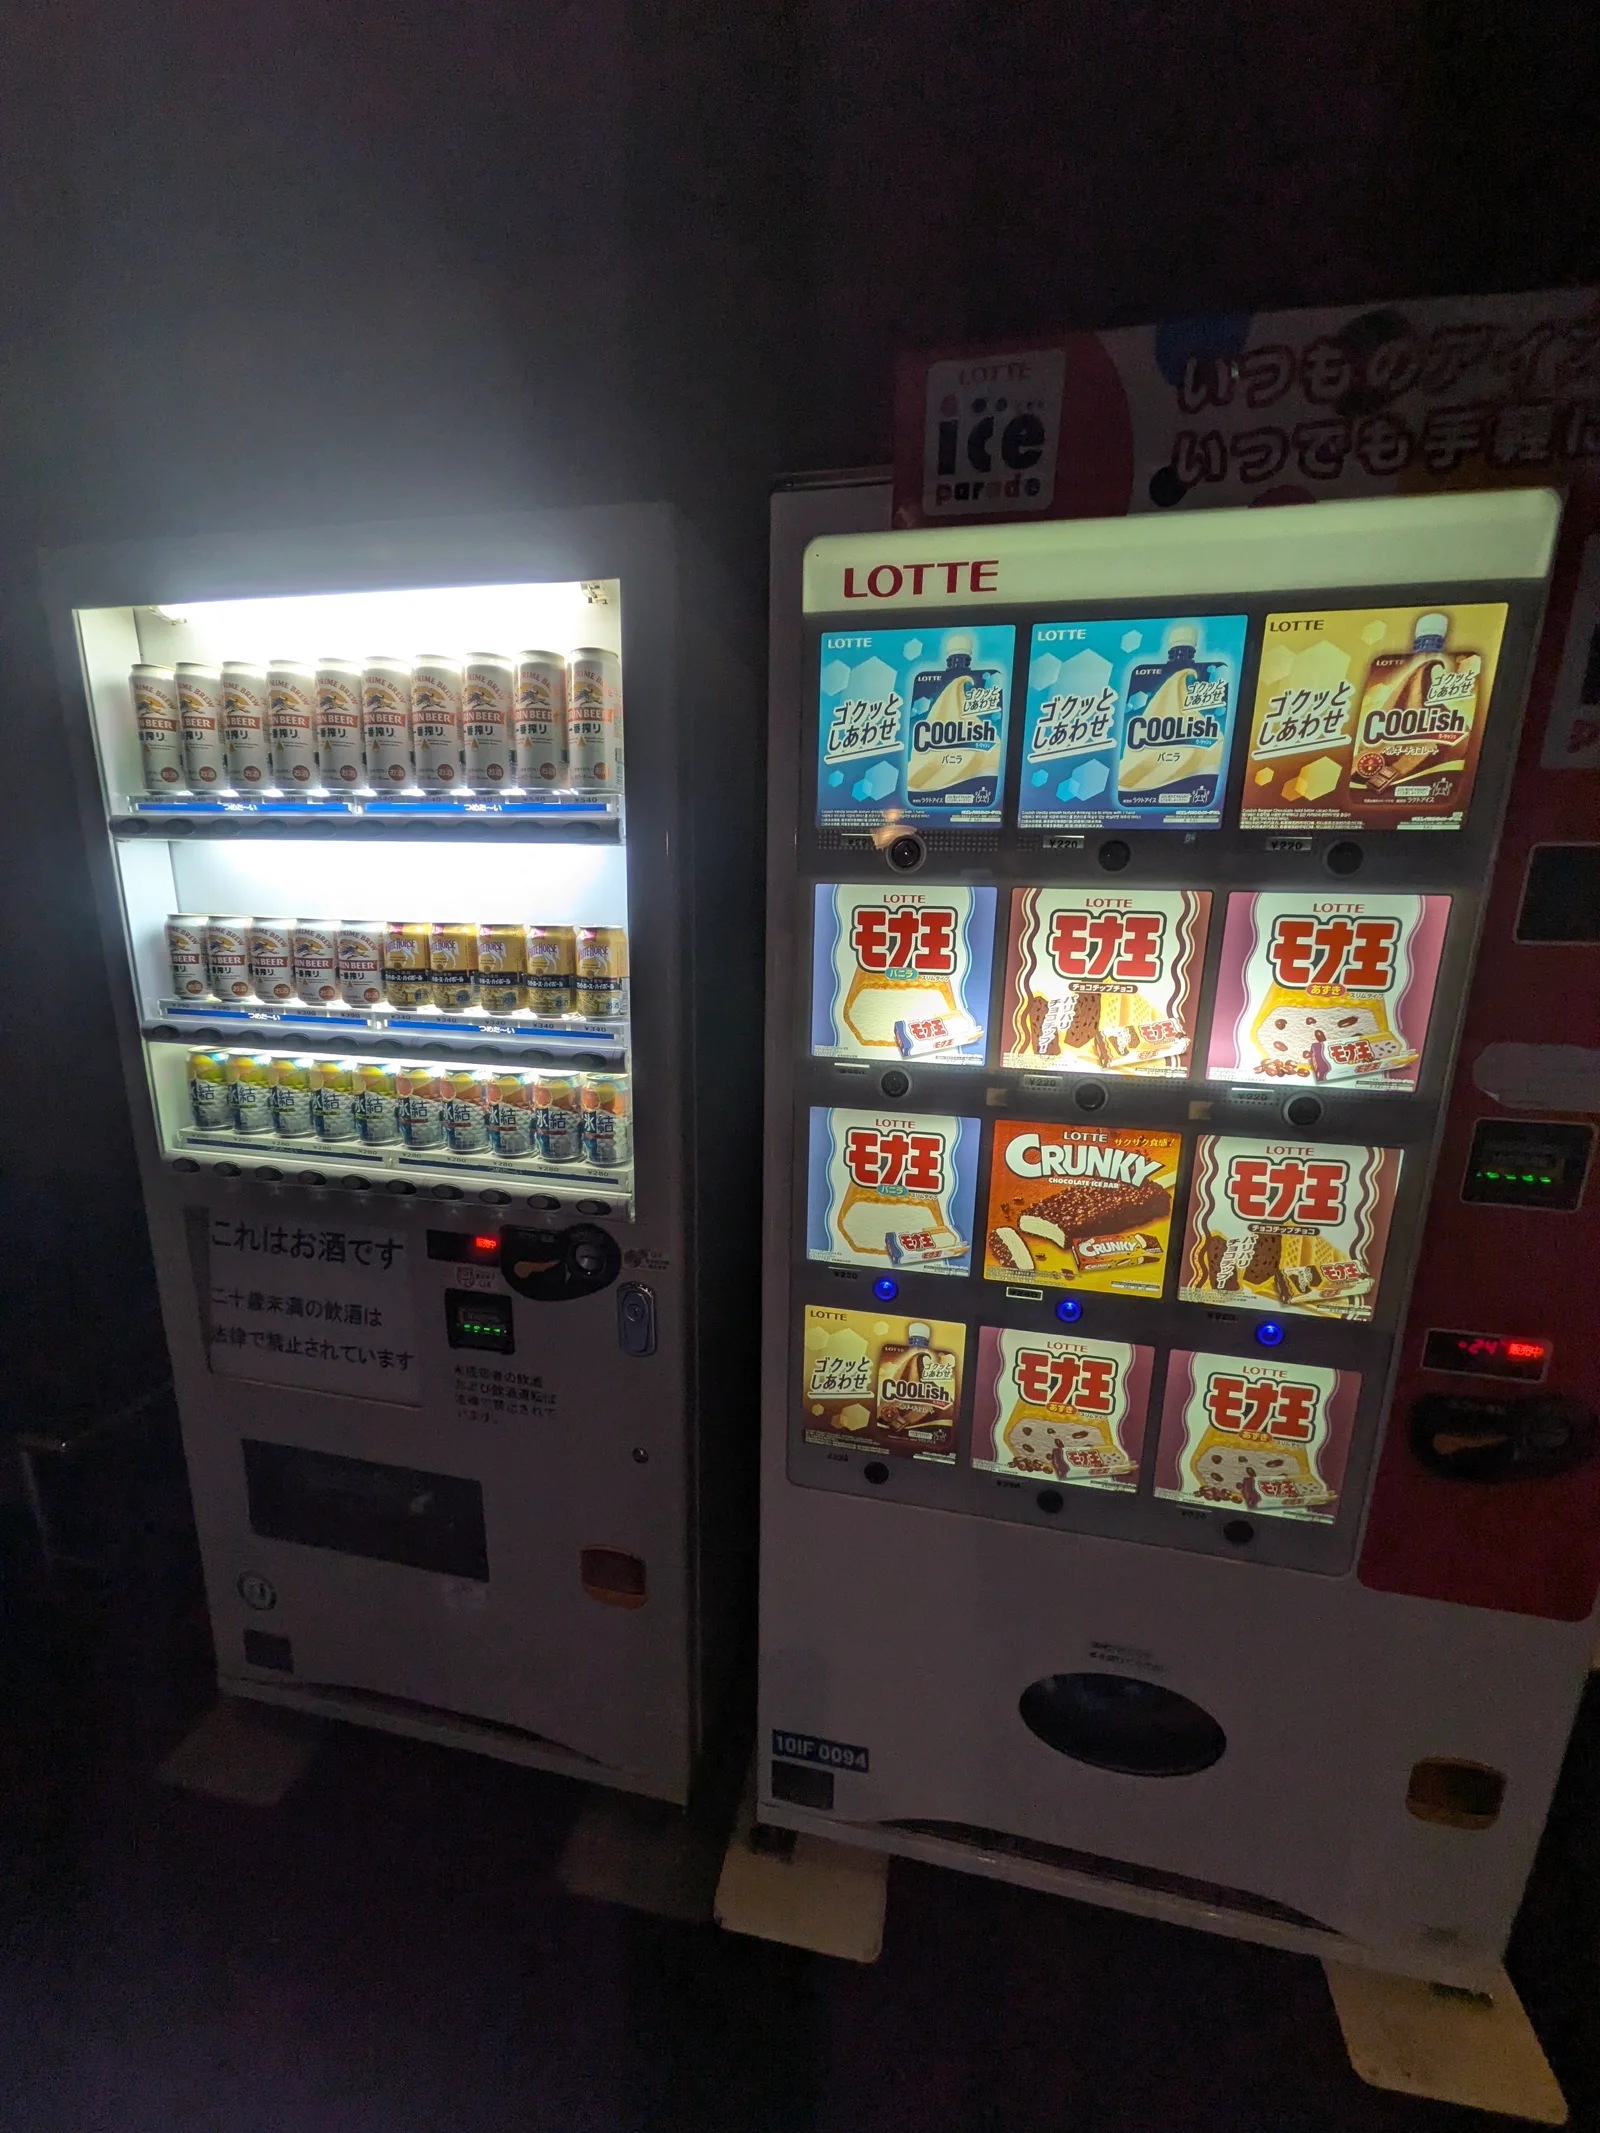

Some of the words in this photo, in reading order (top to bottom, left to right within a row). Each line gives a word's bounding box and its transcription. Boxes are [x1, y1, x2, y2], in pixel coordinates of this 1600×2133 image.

[937, 393, 1046, 476] ice
[843, 559, 999, 598] LOTTE
[1270, 620, 1324, 632] LOTTE
[1038, 629, 1086, 641] LOTTE
[828, 638, 872, 649] LOTTE
[1434, 670, 1475, 686] ゴクッと
[966, 686, 998, 700] ゴクッと
[1188, 679, 1224, 694] ゴクッと
[1429, 683, 1472, 699] しあわせ
[291, 686, 310, 706] BREW
[1185, 690, 1222, 707] しあわせ
[1267, 681, 1350, 719] ゴクッと
[833, 693, 899, 727] ゴクッと
[963, 698, 997, 712] しあわせ
[1040, 688, 1113, 724] ゴクッと
[145, 719, 172, 729] BEER
[185, 718, 211, 728] BEER
[231, 717, 256, 727] BEER
[280, 715, 305, 726] BEER
[328, 715, 354, 725] BEER
[376, 713, 401, 724] BEER
[425, 712, 451, 723] BEER
[475, 711, 501, 722] BEER
[1033, 714, 1110, 749] しあわせ
[1127, 716, 1218, 750] COOLish
[1259, 710, 1344, 746] しあわせ
[1364, 709, 1465, 744] COOLish
[828, 720, 897, 751] しあわせ
[914, 721, 995, 751] COOLish
[942, 755, 962, 764] バニラ
[1157, 753, 1180, 762] バニラ
[1049, 840, 1077, 848] ¥220
[1271, 841, 1302, 850] ¥220
[884, 895, 925, 903] LOTTE
[1086, 898, 1132, 908] LOTTE
[1313, 903, 1364, 913] LOTTE
[181, 929, 199, 945] BREW
[226, 930, 245, 946] BREW
[316, 933, 333, 949] BREW
[361, 935, 378, 951] BREW
[853, 909, 954, 971] モナ王
[1050, 912, 1163, 979] モナ王
[1271, 919, 1397, 988] モナ王
[219, 956, 241, 964] BEER
[261, 958, 284, 966] BEER
[352, 962, 374, 970] BEER
[889, 968, 914, 978] バニラ
[1072, 983, 1134, 993] チョコチップチョコ
[1310, 984, 1341, 996] あずき
[1060, 994, 1079, 1029] パリパリ
[910, 1019, 947, 1039] モナ王
[1141, 1022, 1177, 1042] モナ王
[1330, 1041, 1373, 1063] モナ王
[1030, 1079, 1056, 1087] ¥220
[312, 1093, 340, 1110] 氷結
[355, 1095, 383, 1114] 氷結
[399, 1101, 428, 1118] 氷結
[443, 1104, 470, 1122] 氷結
[489, 1107, 516, 1125] 氷結
[536, 1112, 566, 1129] 氷結
[584, 1115, 613, 1133] 氷結
[876, 1119, 915, 1128] LOTTE
[1064, 1131, 1107, 1142] LOTTE
[1266, 1146, 1315, 1156] LOTTE
[847, 1130, 942, 1191] モナ王
[1005, 1133, 1163, 1187] CRUNKY
[1049, 1178, 1089, 1186] CHOCOLATE
[1229, 1159, 1345, 1223] モナ王
[1252, 1225, 1316, 1235] チョコチップチョコ
[212, 1219, 404, 1270] これはお酒です
[901, 1233, 934, 1249] モナ王
[1079, 1239, 1137, 1257] CRUNKY
[922, 1251, 942, 1259] モナ王
[1237, 1234, 1257, 1268] パリパリ
[1321, 1262, 1361, 1281] モナ王
[810, 1310, 847, 1321] LOTTE
[1047, 1341, 1088, 1352] LOTTE
[815, 1356, 870, 1373] ゴクッと
[1242, 1366, 1288, 1378] LOTTE
[811, 1374, 867, 1390] しあわせ
[1015, 1350, 1114, 1412] モナ王
[882, 1379, 949, 1402] COOLish
[1049, 1404, 1073, 1414] あずき
[1207, 1375, 1315, 1440] モナ王
[1242, 1431, 1269, 1442] あずき
[1067, 1451, 1102, 1467] モナ王
[1260, 1480, 1298, 1497] モナ王
[818, 1744, 866, 1768] 0094
